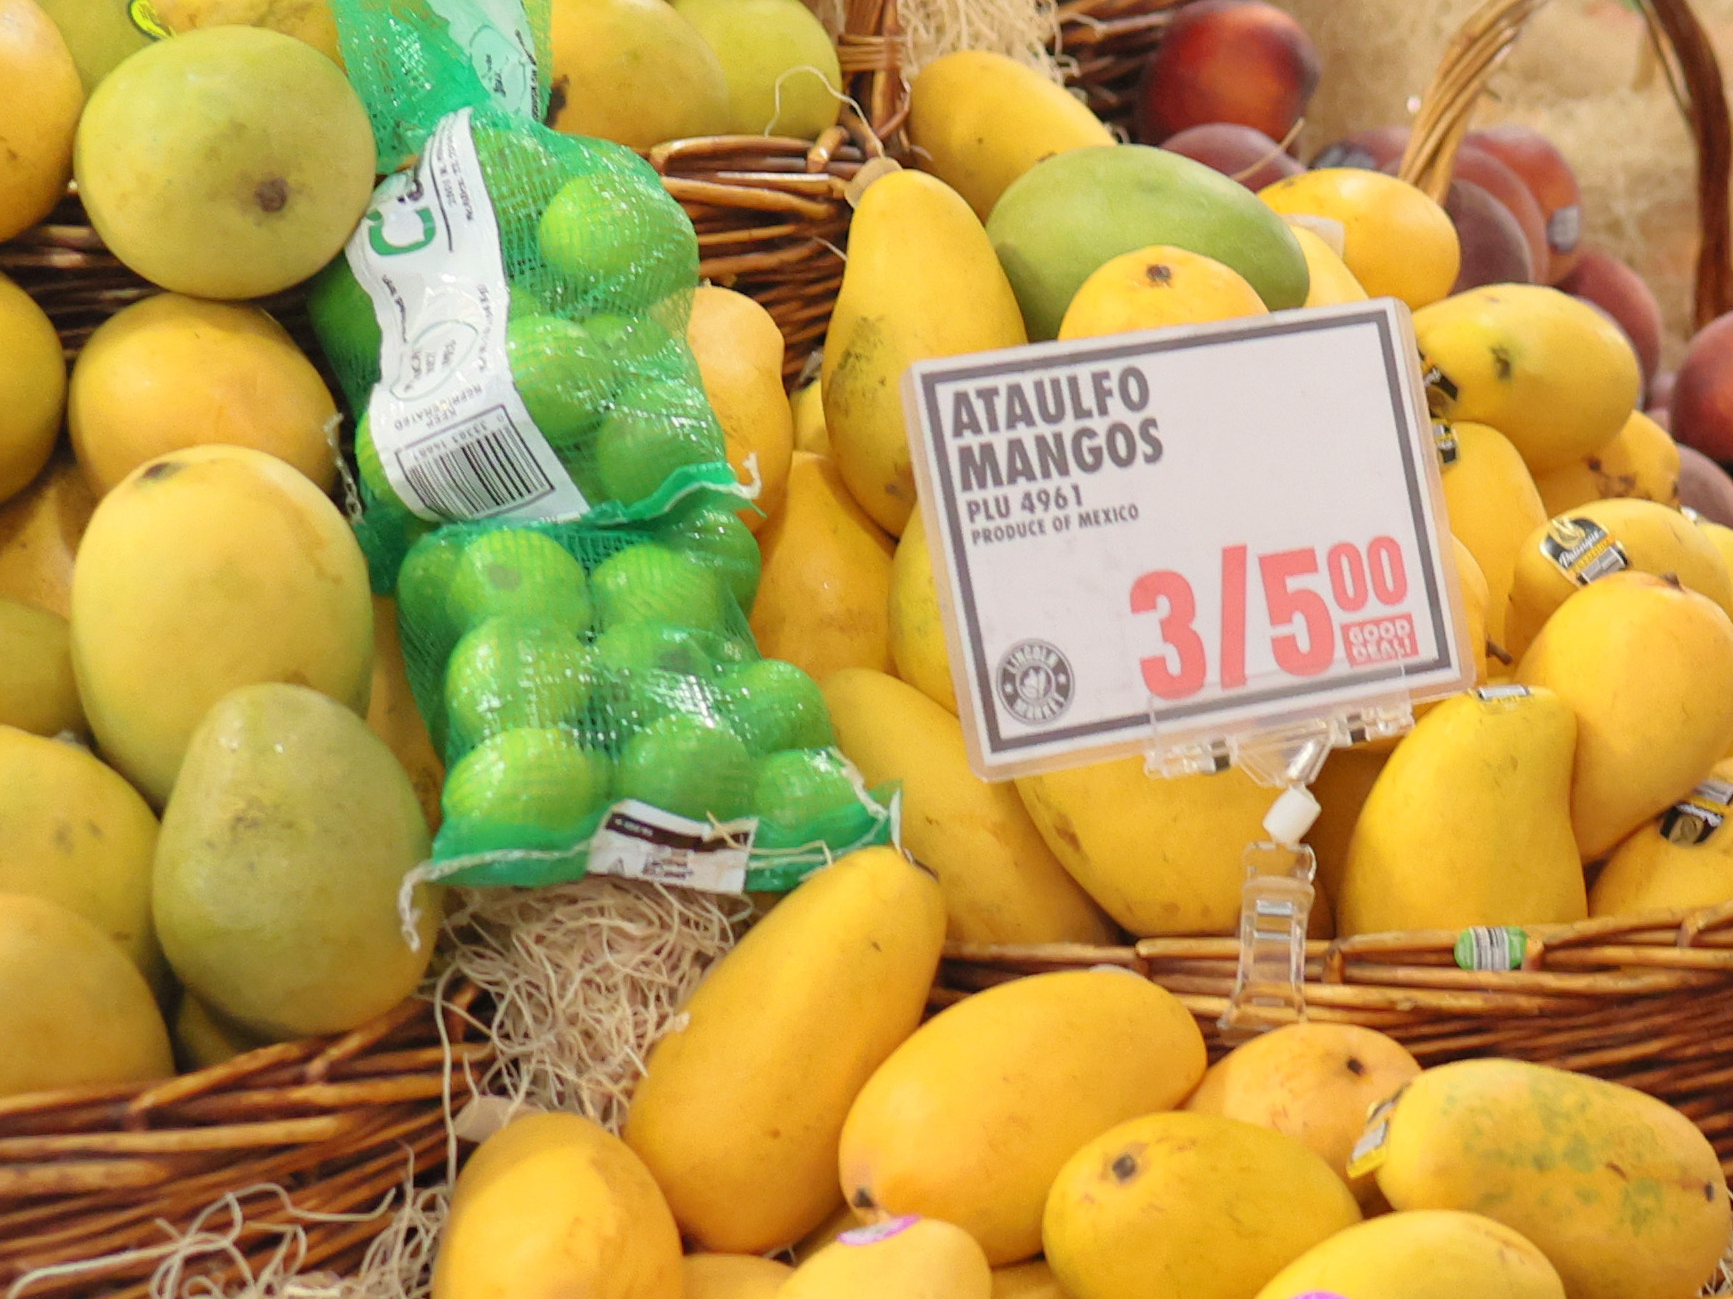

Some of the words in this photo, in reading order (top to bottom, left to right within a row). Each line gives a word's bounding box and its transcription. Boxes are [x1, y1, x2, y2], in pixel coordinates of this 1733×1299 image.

[952, 366, 1149, 439] ATAULFO
[958, 418, 1163, 492] MANGOS
[966, 495, 1011, 523] PLU
[1021, 483, 1083, 515] 4961
[972, 517, 1047, 546] PRODUCE
[1052, 515, 1071, 533] OF
[1078, 503, 1140, 528] MEXICO
[1348, 618, 1411, 645] GOOD
